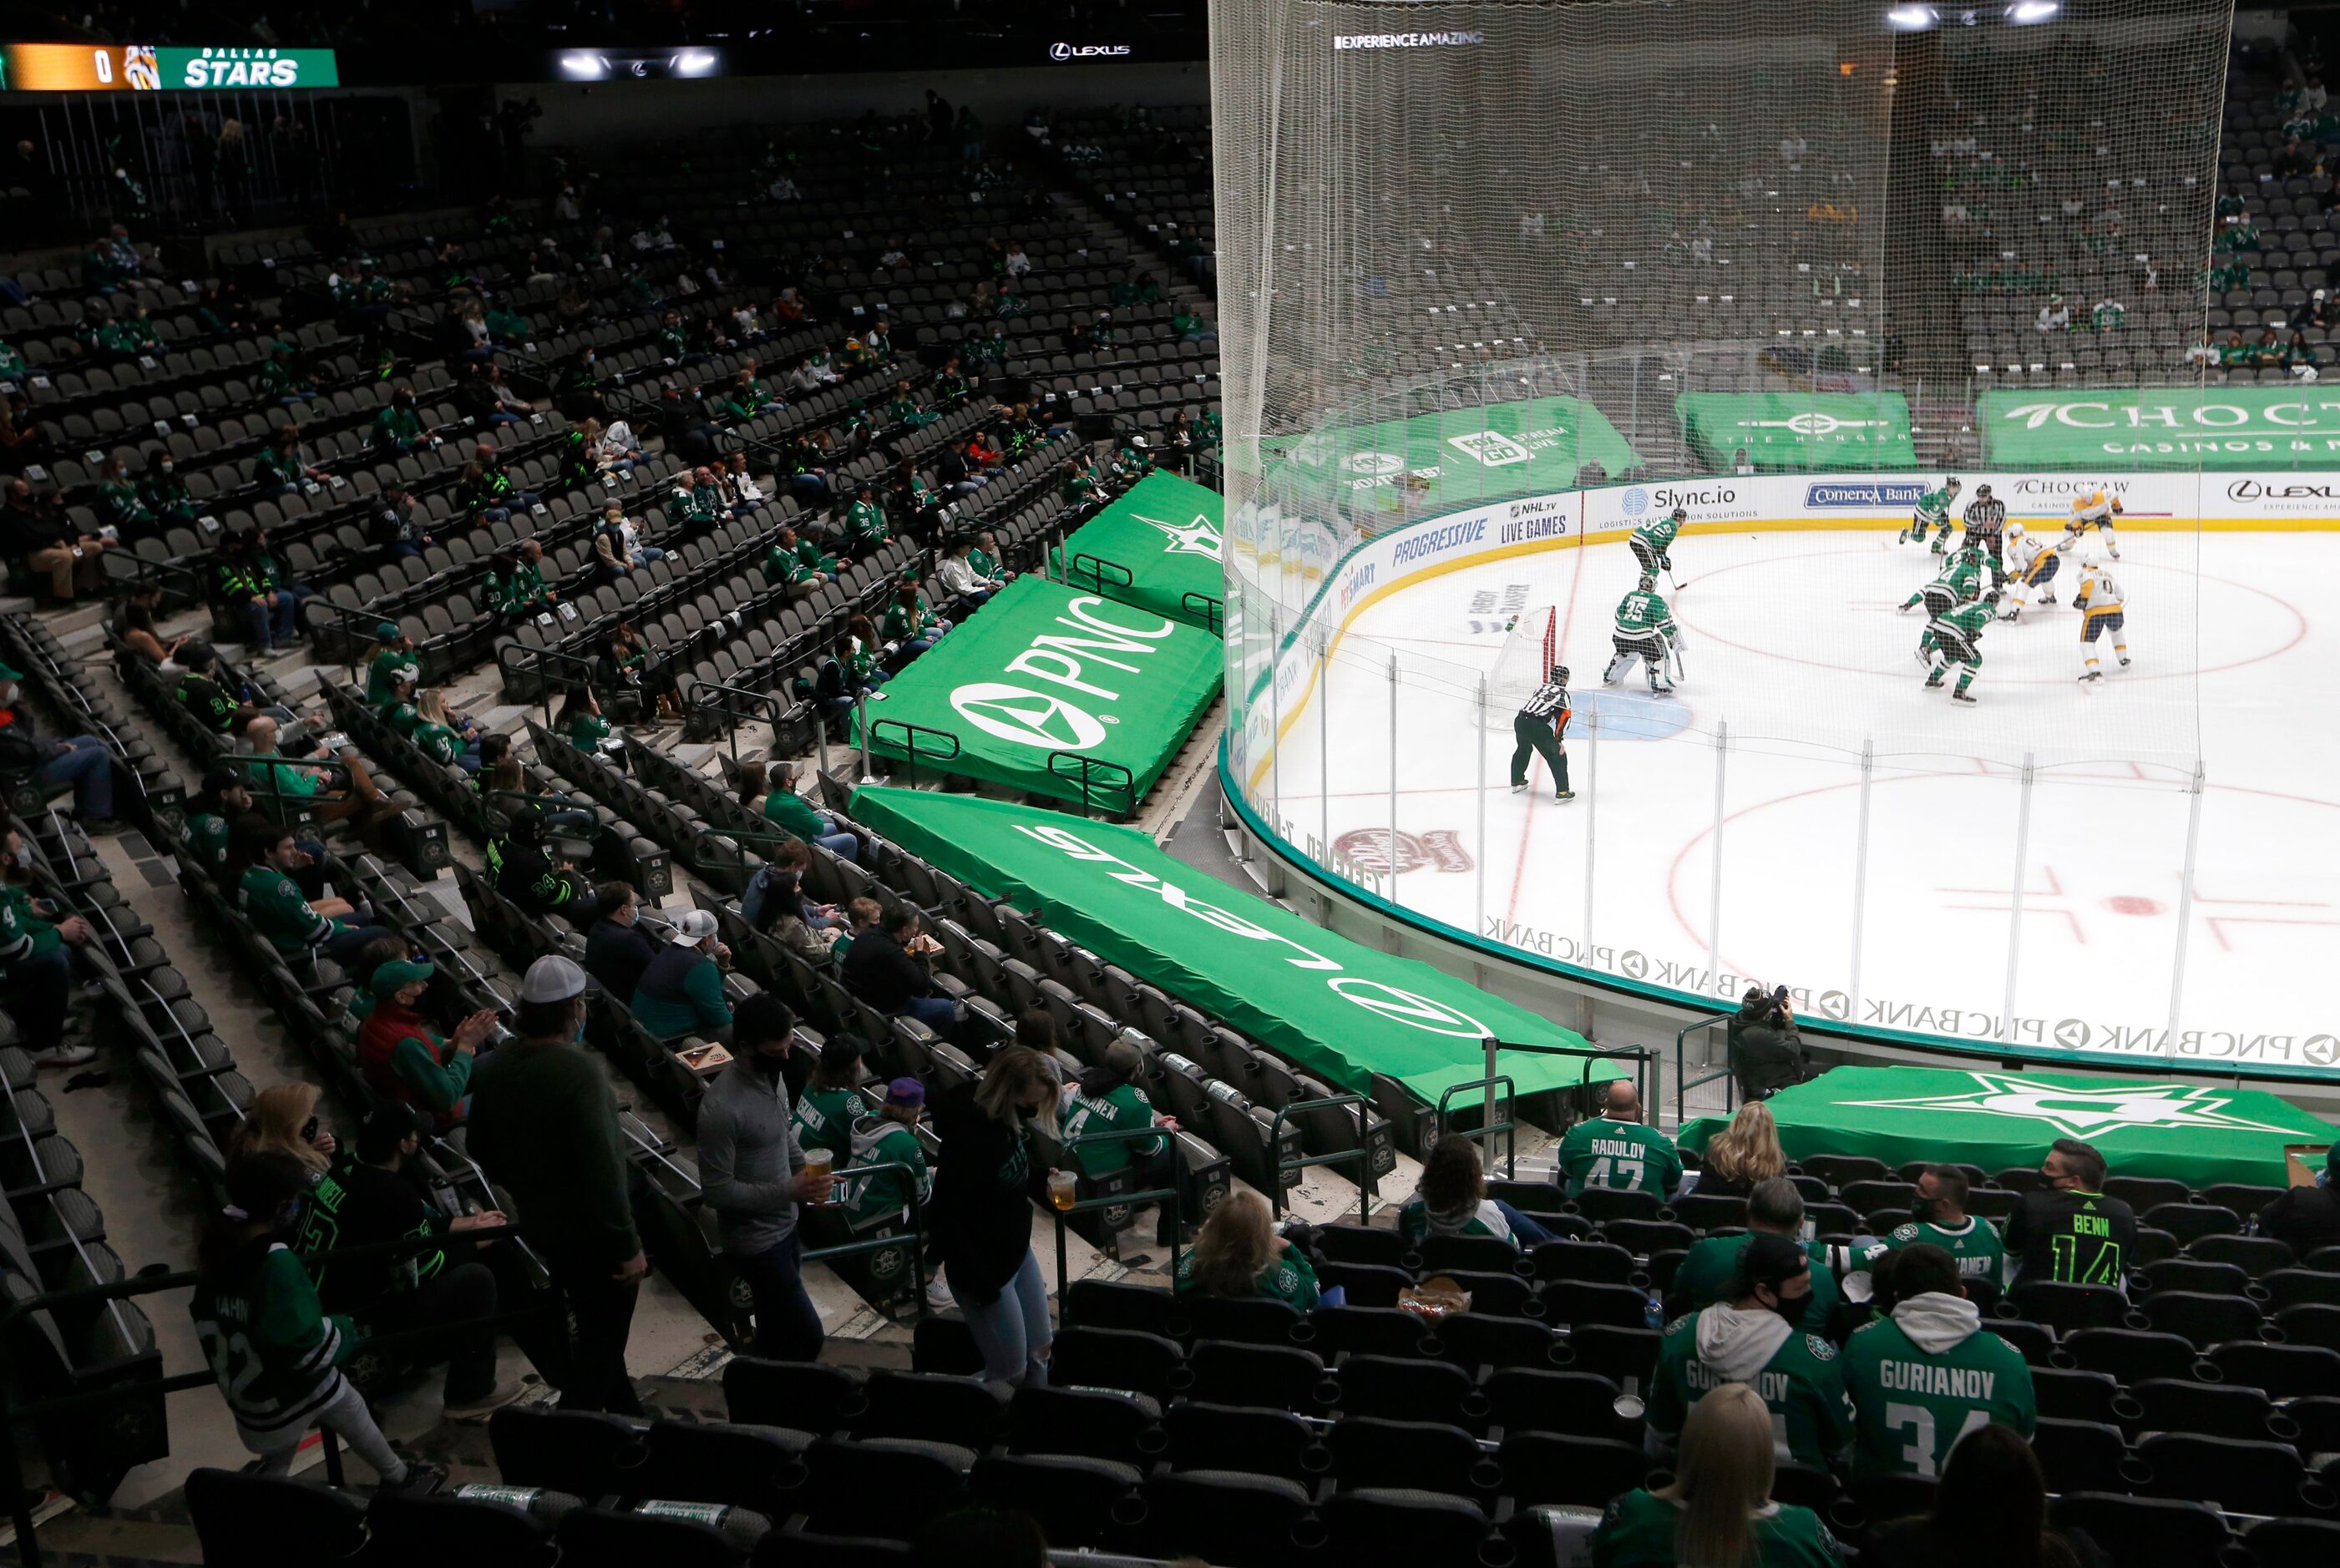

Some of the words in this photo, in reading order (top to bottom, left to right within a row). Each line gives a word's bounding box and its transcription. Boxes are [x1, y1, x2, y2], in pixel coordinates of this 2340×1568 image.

[1072, 45, 1131, 56] LEXUS
[1342, 33, 1418, 48] EXPERIENCE
[1420, 31, 1484, 46] AMAZING
[202, 48, 278, 58] DALLAS
[94, 50, 113, 83] 0
[184, 59, 298, 87] STARS
[1726, 436, 1773, 444] THE
[1796, 433, 1907, 443] HANGAR
[2103, 439, 2273, 453] CASINOS
[1654, 485, 1735, 508] Slync.io
[1886, 487, 1922, 501] Bank
[1522, 501, 1557, 515] NHL.TV
[1706, 509, 1758, 520] SOLUTIONS
[1501, 522, 1524, 544] LIVE
[1527, 514, 1567, 539] GAMES
[1392, 518, 1488, 569] PROGRESSIVE
[1005, 596, 1174, 701] PNC
[1592, 1138, 1646, 1160] RADULOV
[1584, 1156, 1644, 1191] 47
[2074, 1214, 2110, 1237] BENN
[2052, 1234, 2120, 1287] 14
[1880, 1358, 1994, 1401] GURIANOV
